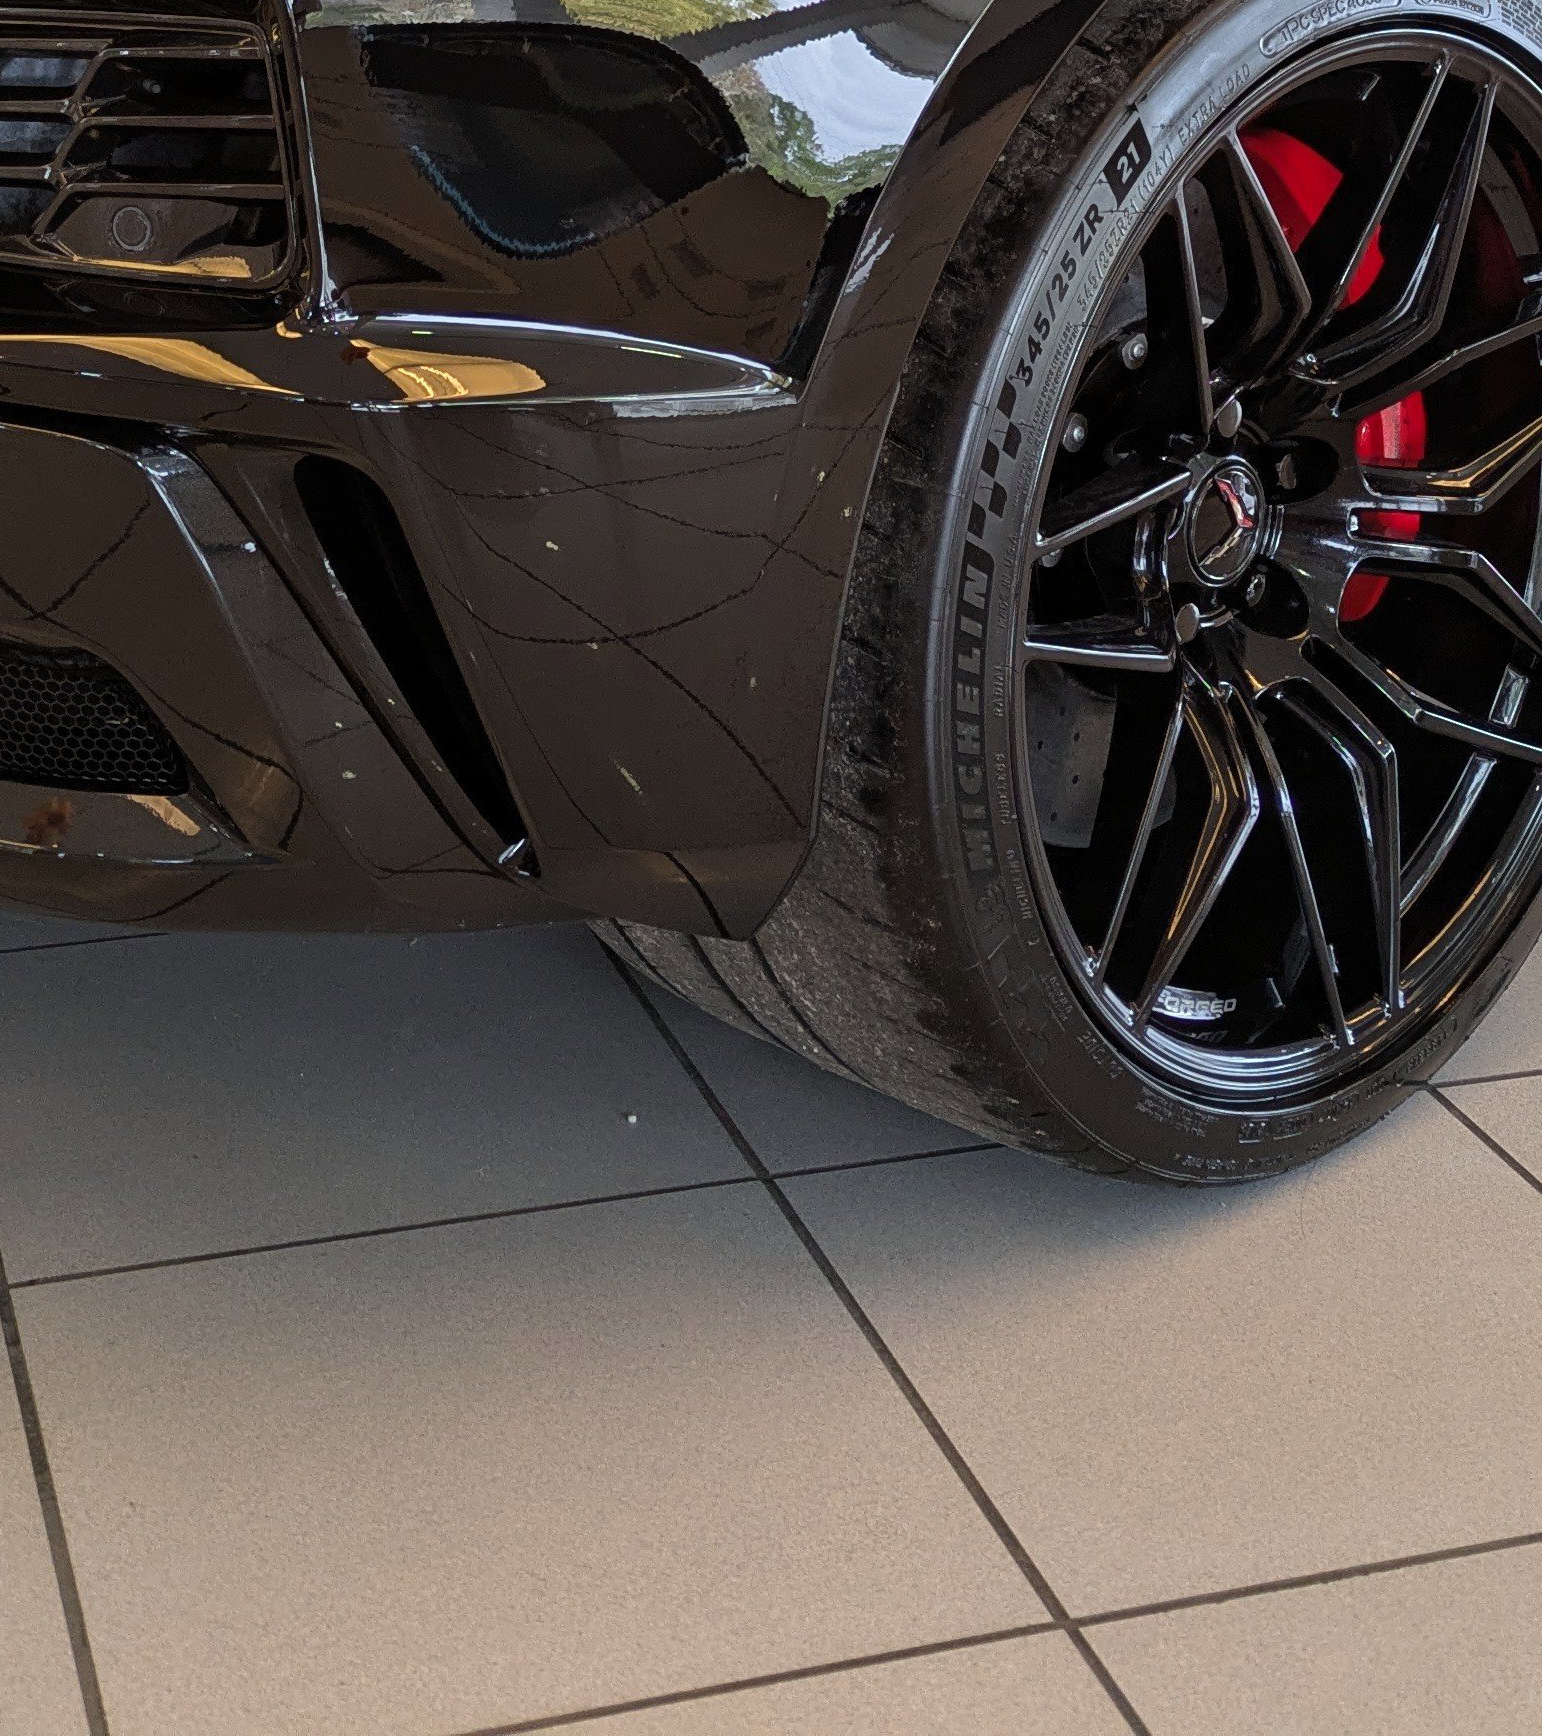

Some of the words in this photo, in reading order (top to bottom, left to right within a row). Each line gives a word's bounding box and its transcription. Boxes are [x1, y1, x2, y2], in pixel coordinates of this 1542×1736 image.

[1178, 95, 1218, 146] EXTRA
[1219, 63, 1250, 105] LOAD
[1015, 252, 1078, 387] 345/25
[1071, 203, 1105, 257] ZR
[1116, 141, 1144, 185] 21
[955, 562, 994, 873] MICHELIN
